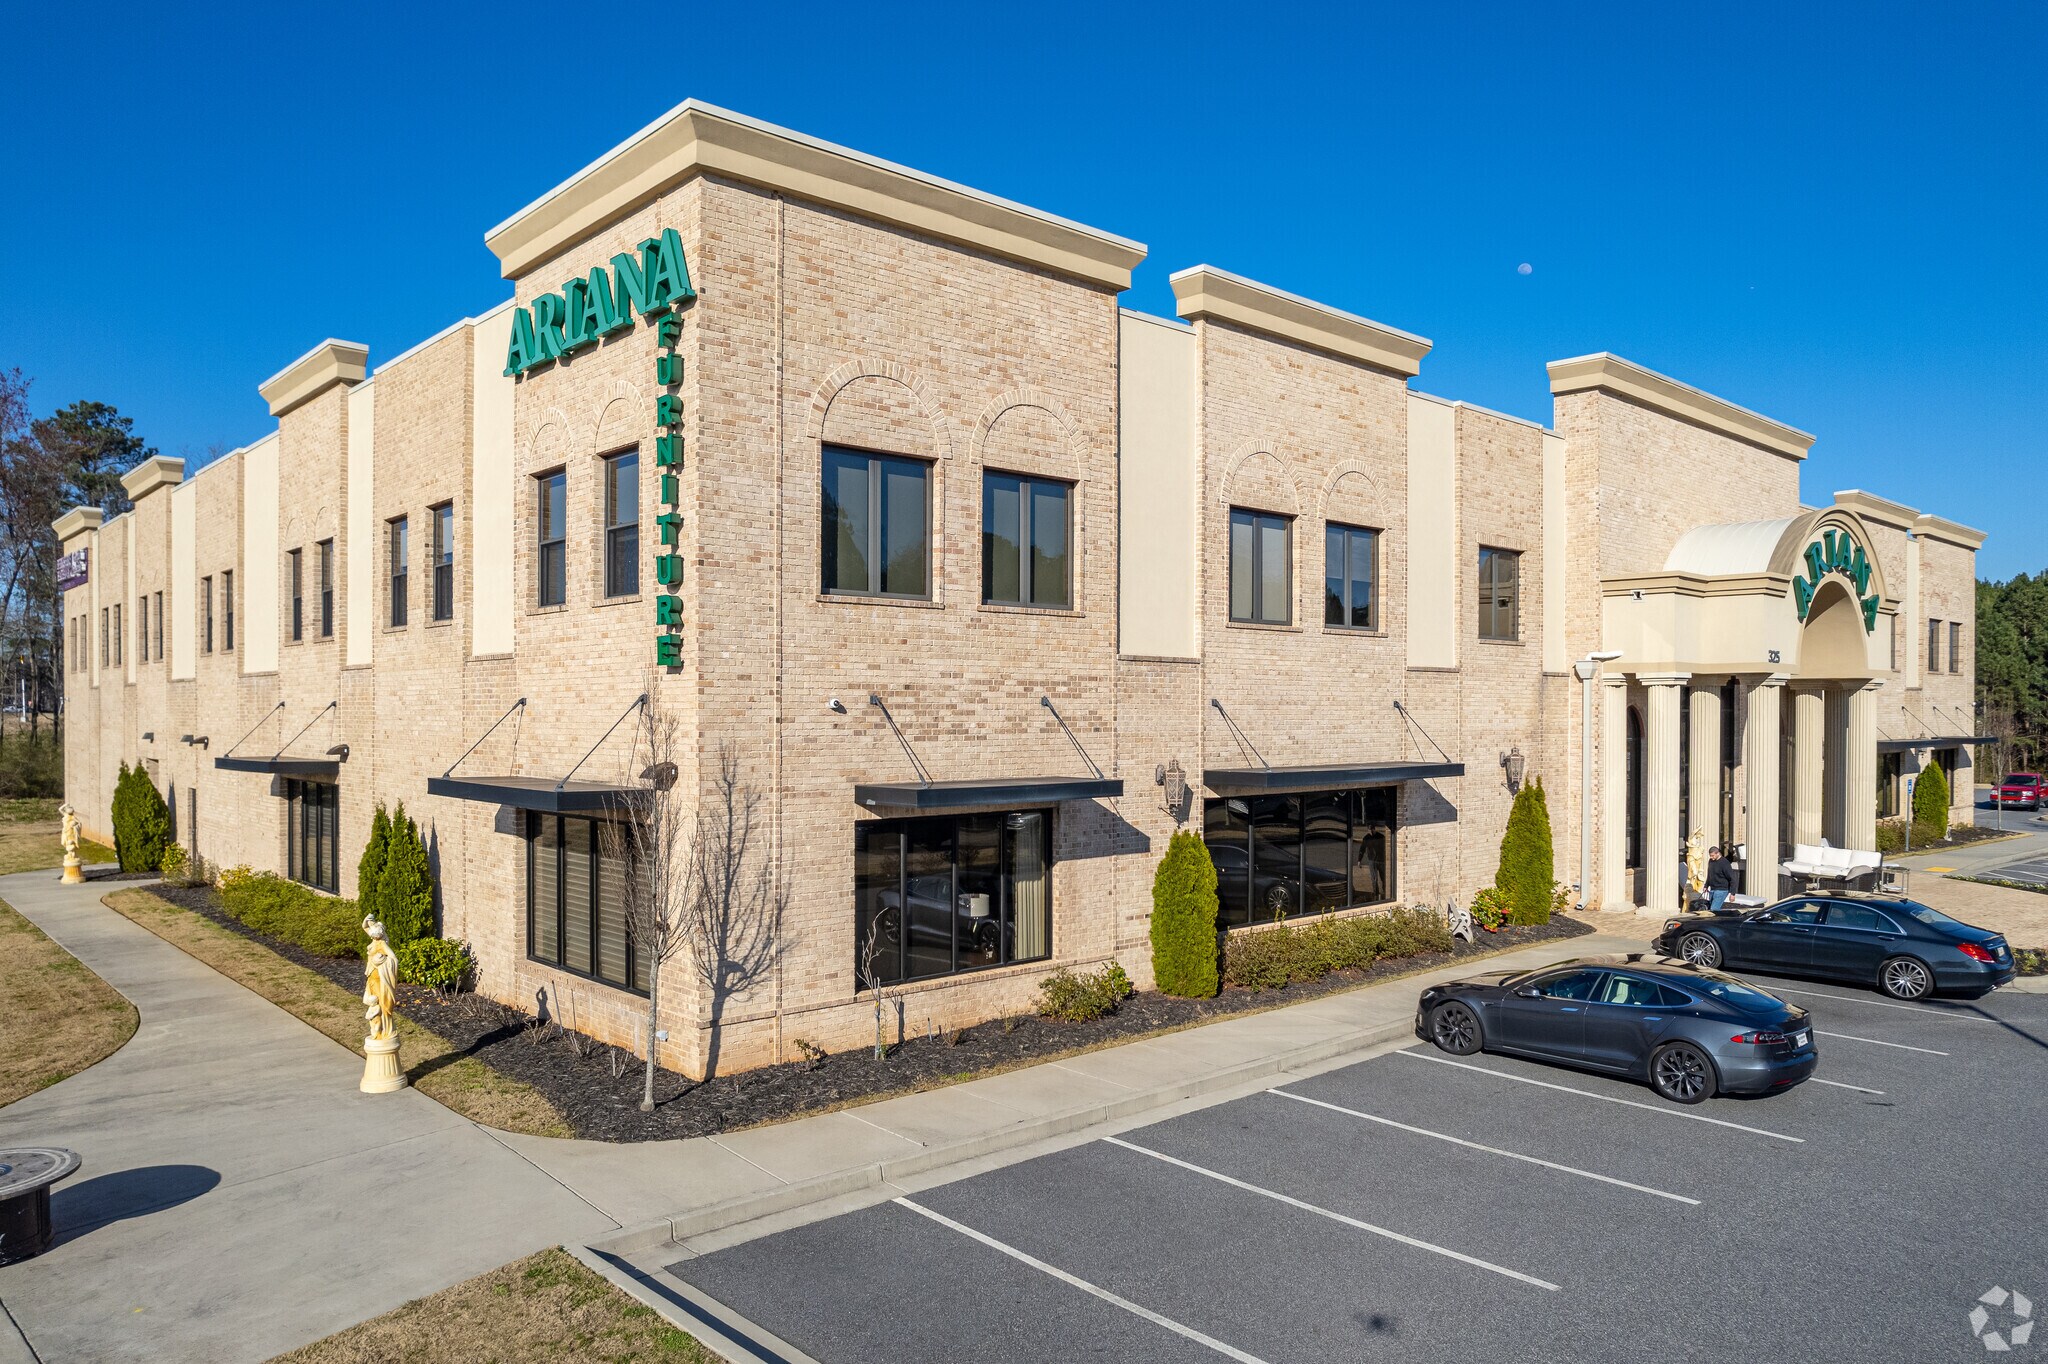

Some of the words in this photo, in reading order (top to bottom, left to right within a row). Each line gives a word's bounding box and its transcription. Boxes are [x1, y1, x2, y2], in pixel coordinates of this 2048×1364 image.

[504, 228, 696, 376] ARIANA
[657, 312, 683, 667] FURNITURE
[1793, 529, 1880, 631] ARIANA
[1768, 649, 1780, 663] 325
